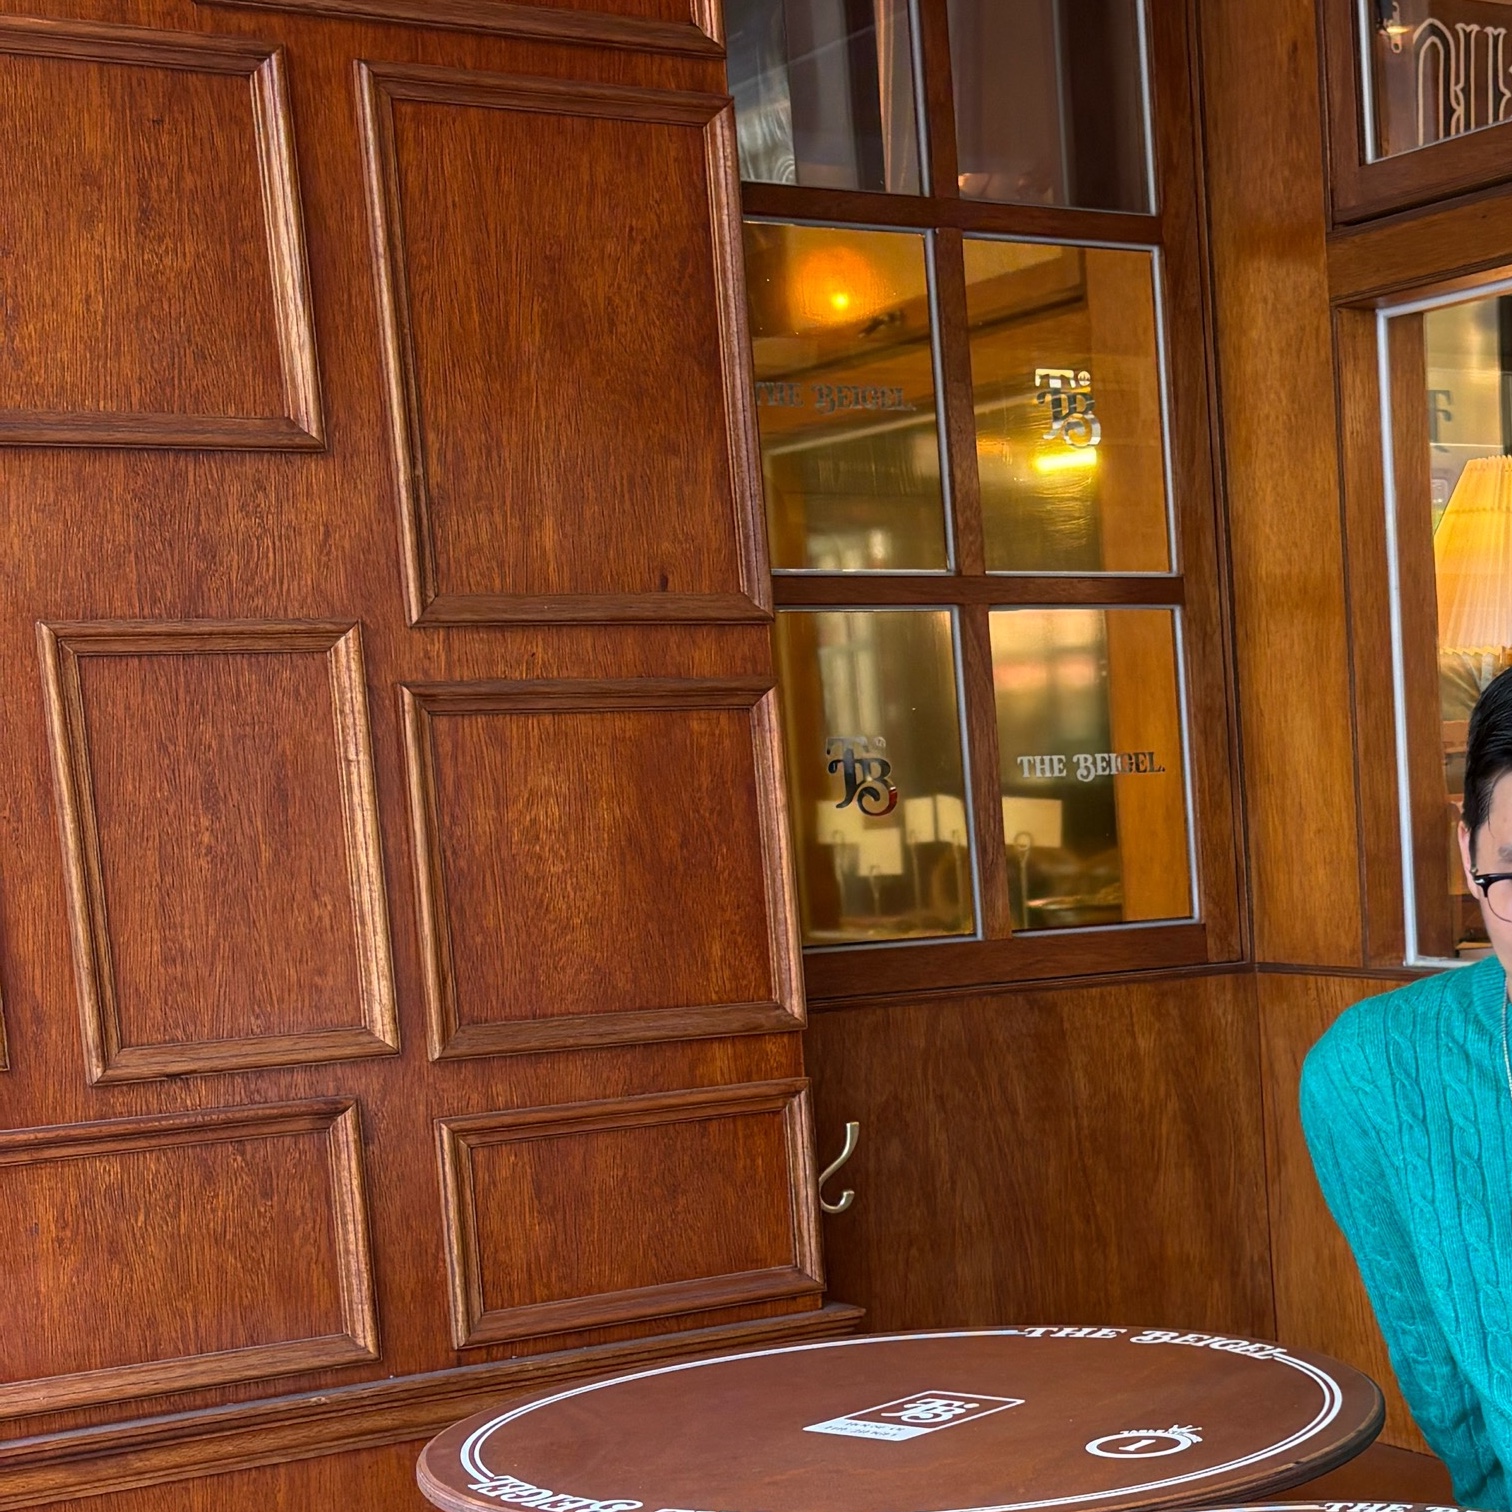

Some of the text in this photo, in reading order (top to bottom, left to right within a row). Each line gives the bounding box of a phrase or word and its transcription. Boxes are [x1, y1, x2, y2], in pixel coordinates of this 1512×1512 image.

[1017, 755, 1067, 778] THE
[1024, 1327, 1287, 1360] THE BEIGEL
